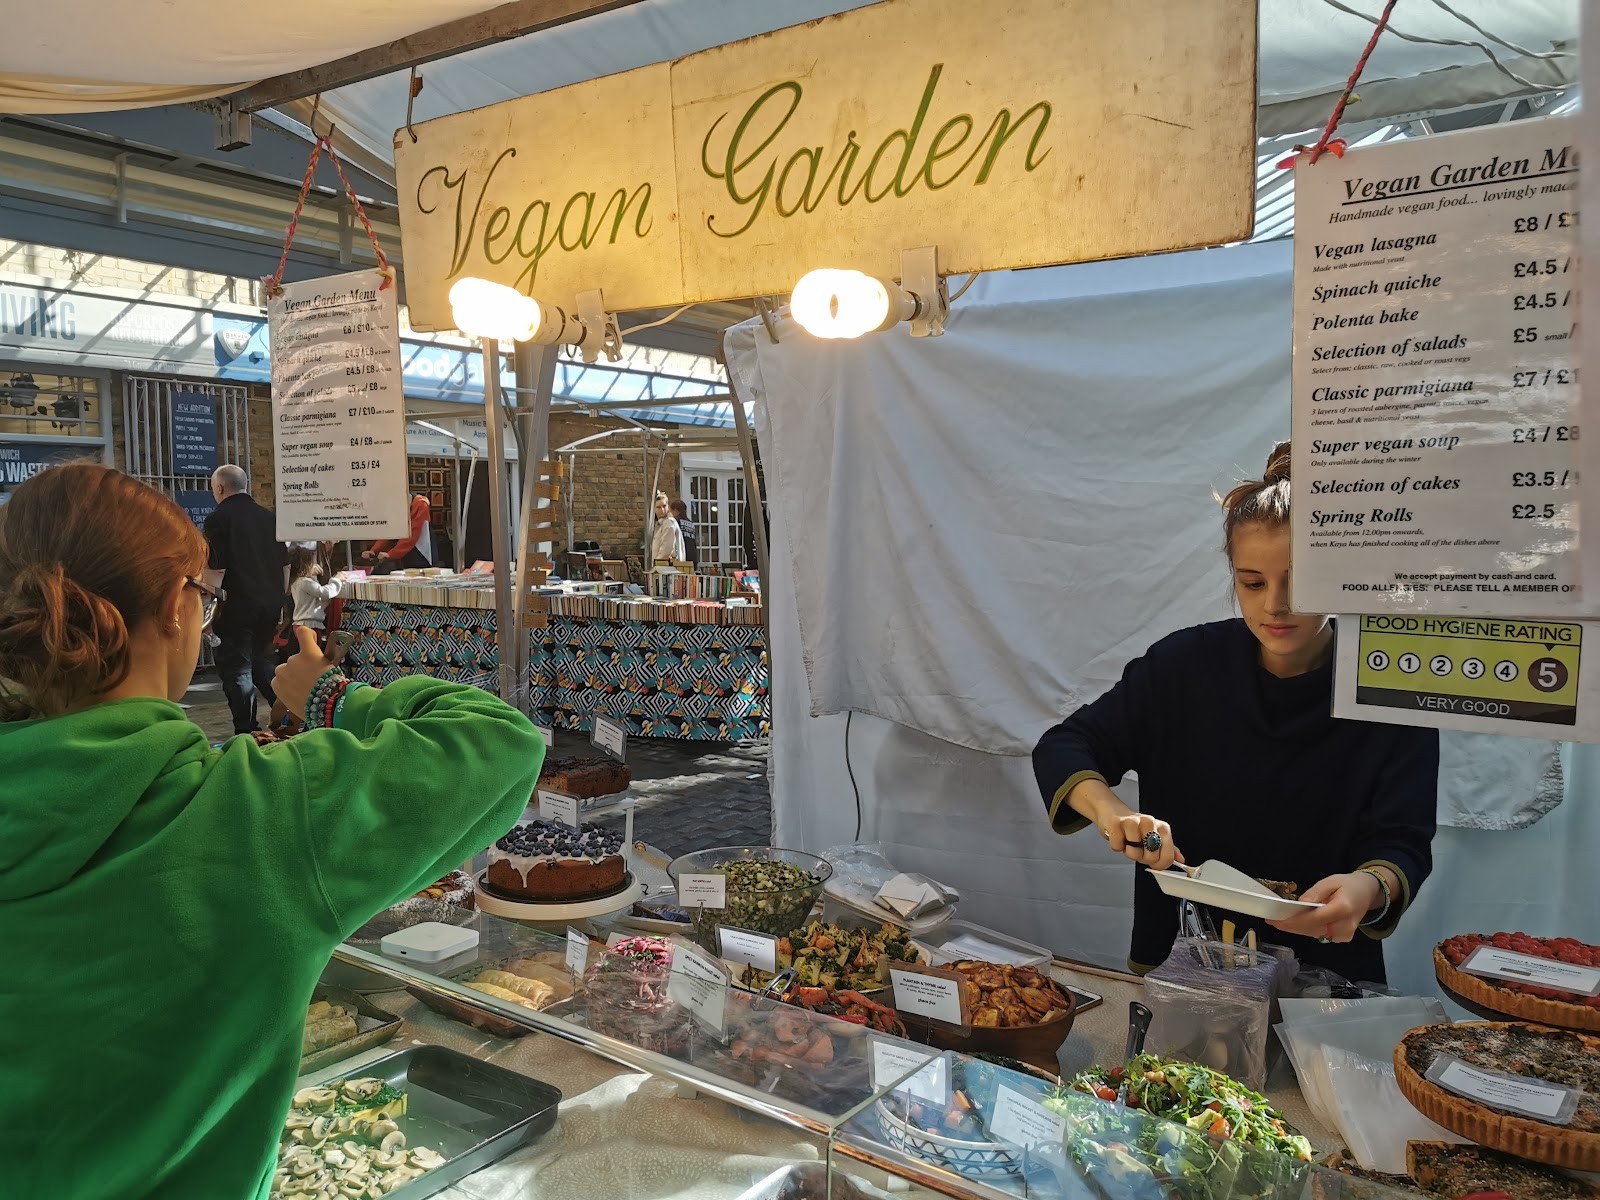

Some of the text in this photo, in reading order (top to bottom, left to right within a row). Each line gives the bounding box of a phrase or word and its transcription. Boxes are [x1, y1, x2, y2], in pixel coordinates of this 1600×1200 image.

[417, 64, 1054, 297] Vegan Garden
[1343, 174, 1420, 200] Vegan
[1430, 155, 1530, 187] Garden
[1329, 185, 1537, 224] Handmade vegan food... lovingly
[1314, 242, 1364, 260] Vegan
[1371, 233, 1437, 251] lasagna
[1514, 216, 1539, 233] £8
[1313, 265, 1331, 273] Made
[1349, 258, 1385, 268] nutritional
[1312, 259, 1557, 303] Spinach quiche £4.5
[285, 288, 376, 311] Vegan Garden Menu
[0, 293, 76, 341] IVING
[1312, 292, 1557, 331] Polenta bake £4.5
[1312, 327, 1568, 361] Selection of salads £5 small
[346, 365, 375, 376] £4.5 £8
[1311, 367, 1332, 375] Select
[1398, 359, 1422, 367] cooked
[369, 382, 378, 391] £8
[1312, 385, 1369, 402] Classic
[1373, 379, 1473, 401] parmigiana
[1513, 371, 1537, 388] £7
[177, 403, 189, 412] NEW
[280, 413, 301, 422] Classic
[302, 411, 336, 422] parmigiana
[348, 408, 357, 417] £7
[362, 406, 376, 416] £10
[1317, 408, 1338, 416] layers
[1339, 406, 1347, 414] of
[1348, 404, 1373, 413] roasted
[1374, 403, 1411, 412] aubergine,
[462, 419, 481, 427] Music
[1311, 418, 1334, 426] cheese,
[1337, 416, 1354, 424] basil
[1364, 414, 1400, 423] nutritional
[281, 442, 298, 452] Super
[300, 443, 318, 451] vegan
[319, 441, 333, 450] soup
[350, 438, 359, 447] £4
[364, 437, 373, 446] £8
[1310, 438, 1360, 456] Super
[1364, 438, 1413, 453] vegan
[1419, 436, 1460, 450] soup
[1513, 428, 1537, 443] £4
[1556, 425, 1580, 441] £8
[282, 460, 380, 474] Selection of cakes £3.5 £4
[1329, 458, 1359, 466] available
[1361, 457, 1384, 465] during
[282, 479, 367, 491] Spring Rolls £2.5
[1310, 472, 1555, 494] Selection of cakes £3.5
[1310, 503, 1555, 527] Spring Rolls £2.5
[1362, 529, 1391, 537] 12.00pm
[1329, 541, 1347, 549] Kaya
[1361, 540, 1389, 548] finished
[1390, 540, 1419, 548] cooking
[1431, 539, 1442, 547] of
[1409, 573, 1438, 581] accept
[1439, 573, 1477, 581] payment
[1478, 573, 1490, 581] by
[1342, 584, 1369, 592] FOOD
[1433, 584, 1473, 592] PLEASE
[1476, 584, 1500, 592] TELL
[1502, 584, 1511, 592] A
[1512, 584, 1558, 592] MEMBER
[1366, 615, 1573, 642] FOOD HYGIENE RATING
[1373, 655, 1558, 688] 0 1 2 3 4 5
[1416, 695, 1510, 715] VERY GOOD
